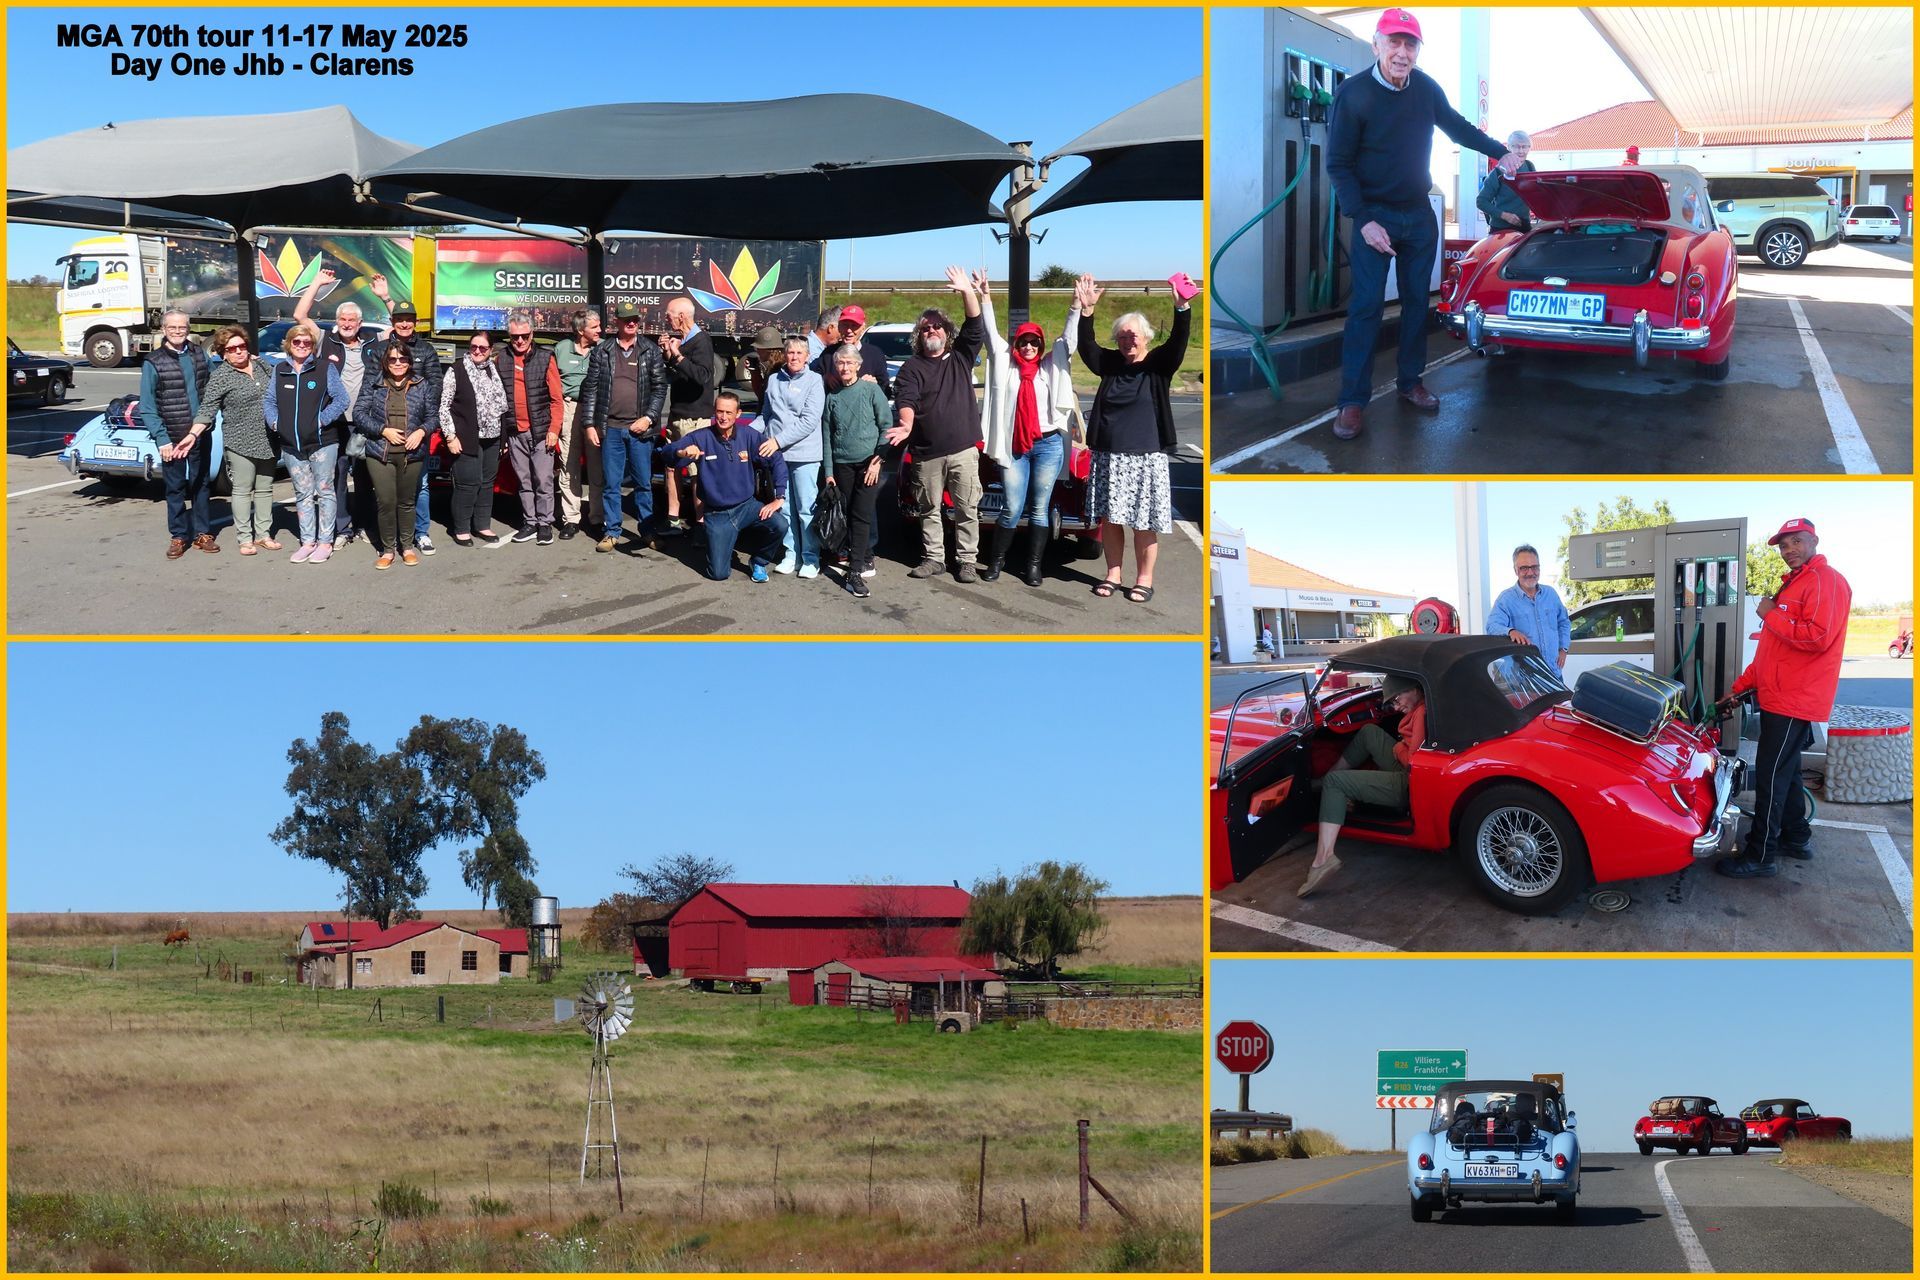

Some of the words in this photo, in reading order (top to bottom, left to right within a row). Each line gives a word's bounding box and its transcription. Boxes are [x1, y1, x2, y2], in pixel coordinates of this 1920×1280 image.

[105, 260, 128, 275] 20
[495, 270, 581, 289] SESFIGILE
[604, 274, 684, 290] OGISTICS
[516, 294, 530, 303] WE
[533, 295, 571, 304] DELIVER
[572, 295, 587, 304] ON
[617, 296, 660, 305] PROMISE
[1511, 293, 1568, 316] CM97MN
[1582, 297, 1602, 317] GP
[1728, 596, 1737, 604] 95
[1221, 1036, 1264, 1057] STOP
[1414, 1056, 1441, 1064] Villiers
[1414, 1066, 1449, 1074] Frankfort
[1414, 1083, 1436, 1091] Vrede
[1467, 1166, 1500, 1177] KV63XH
[1506, 1166, 1517, 1177] GP
